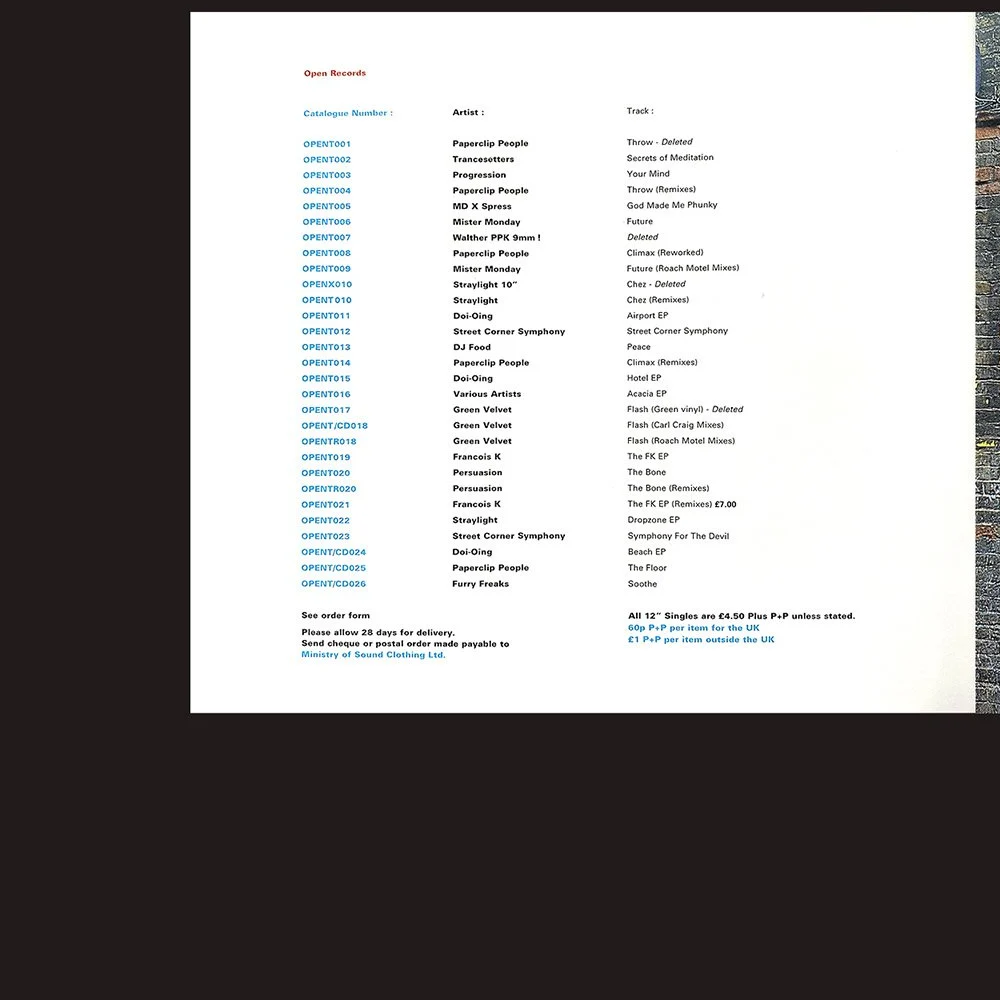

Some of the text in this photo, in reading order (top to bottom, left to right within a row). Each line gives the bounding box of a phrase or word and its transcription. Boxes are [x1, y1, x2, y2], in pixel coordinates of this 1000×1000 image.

[304, 69, 366, 78] Open Records
[303, 140, 350, 148] OPENT001
[452, 139, 529, 149] Paperclip People
[303, 156, 351, 164] OPENT002
[452, 155, 514, 163] Trancesetters
[627, 154, 657, 162] Secrets
[659, 154, 668, 162] of
[302, 233, 351, 241] OPENT007
[655, 264, 684, 272] (Roach
[686, 264, 710, 272] Motel
[712, 264, 740, 272] Mixes)
[302, 280, 352, 288] OPENX010
[453, 312, 493, 321] Doi-Oing
[627, 311, 669, 320] Airport EP
[301, 390, 351, 398] OPENT016
[453, 390, 521, 398] Various Artists
[301, 422, 368, 430] OPENT/CD018
[453, 421, 512, 429] Green Velvet
[627, 421, 724, 430] Flash (Carl Craig Mixes)
[452, 500, 501, 508] Francois K
[628, 500, 737, 508] The FK EP (Remixes) £7.00
[301, 580, 366, 588] OPENT/CD026
[452, 580, 509, 589] Furry Freaks
[628, 580, 657, 588] Soothe
[301, 611, 318, 619] See
[348, 611, 370, 619] form
[664, 612, 698, 621] Singles
[718, 612, 745, 620] £4.50
[748, 612, 768, 620] Plus
[791, 612, 821, 620] unless
[824, 612, 855, 620] stated.
[302, 628, 331, 636] Please
[376, 629, 397, 638] days
[416, 629, 455, 638] delivery.
[301, 650, 339, 660] Ministry
[386, 651, 425, 660] Clothing
